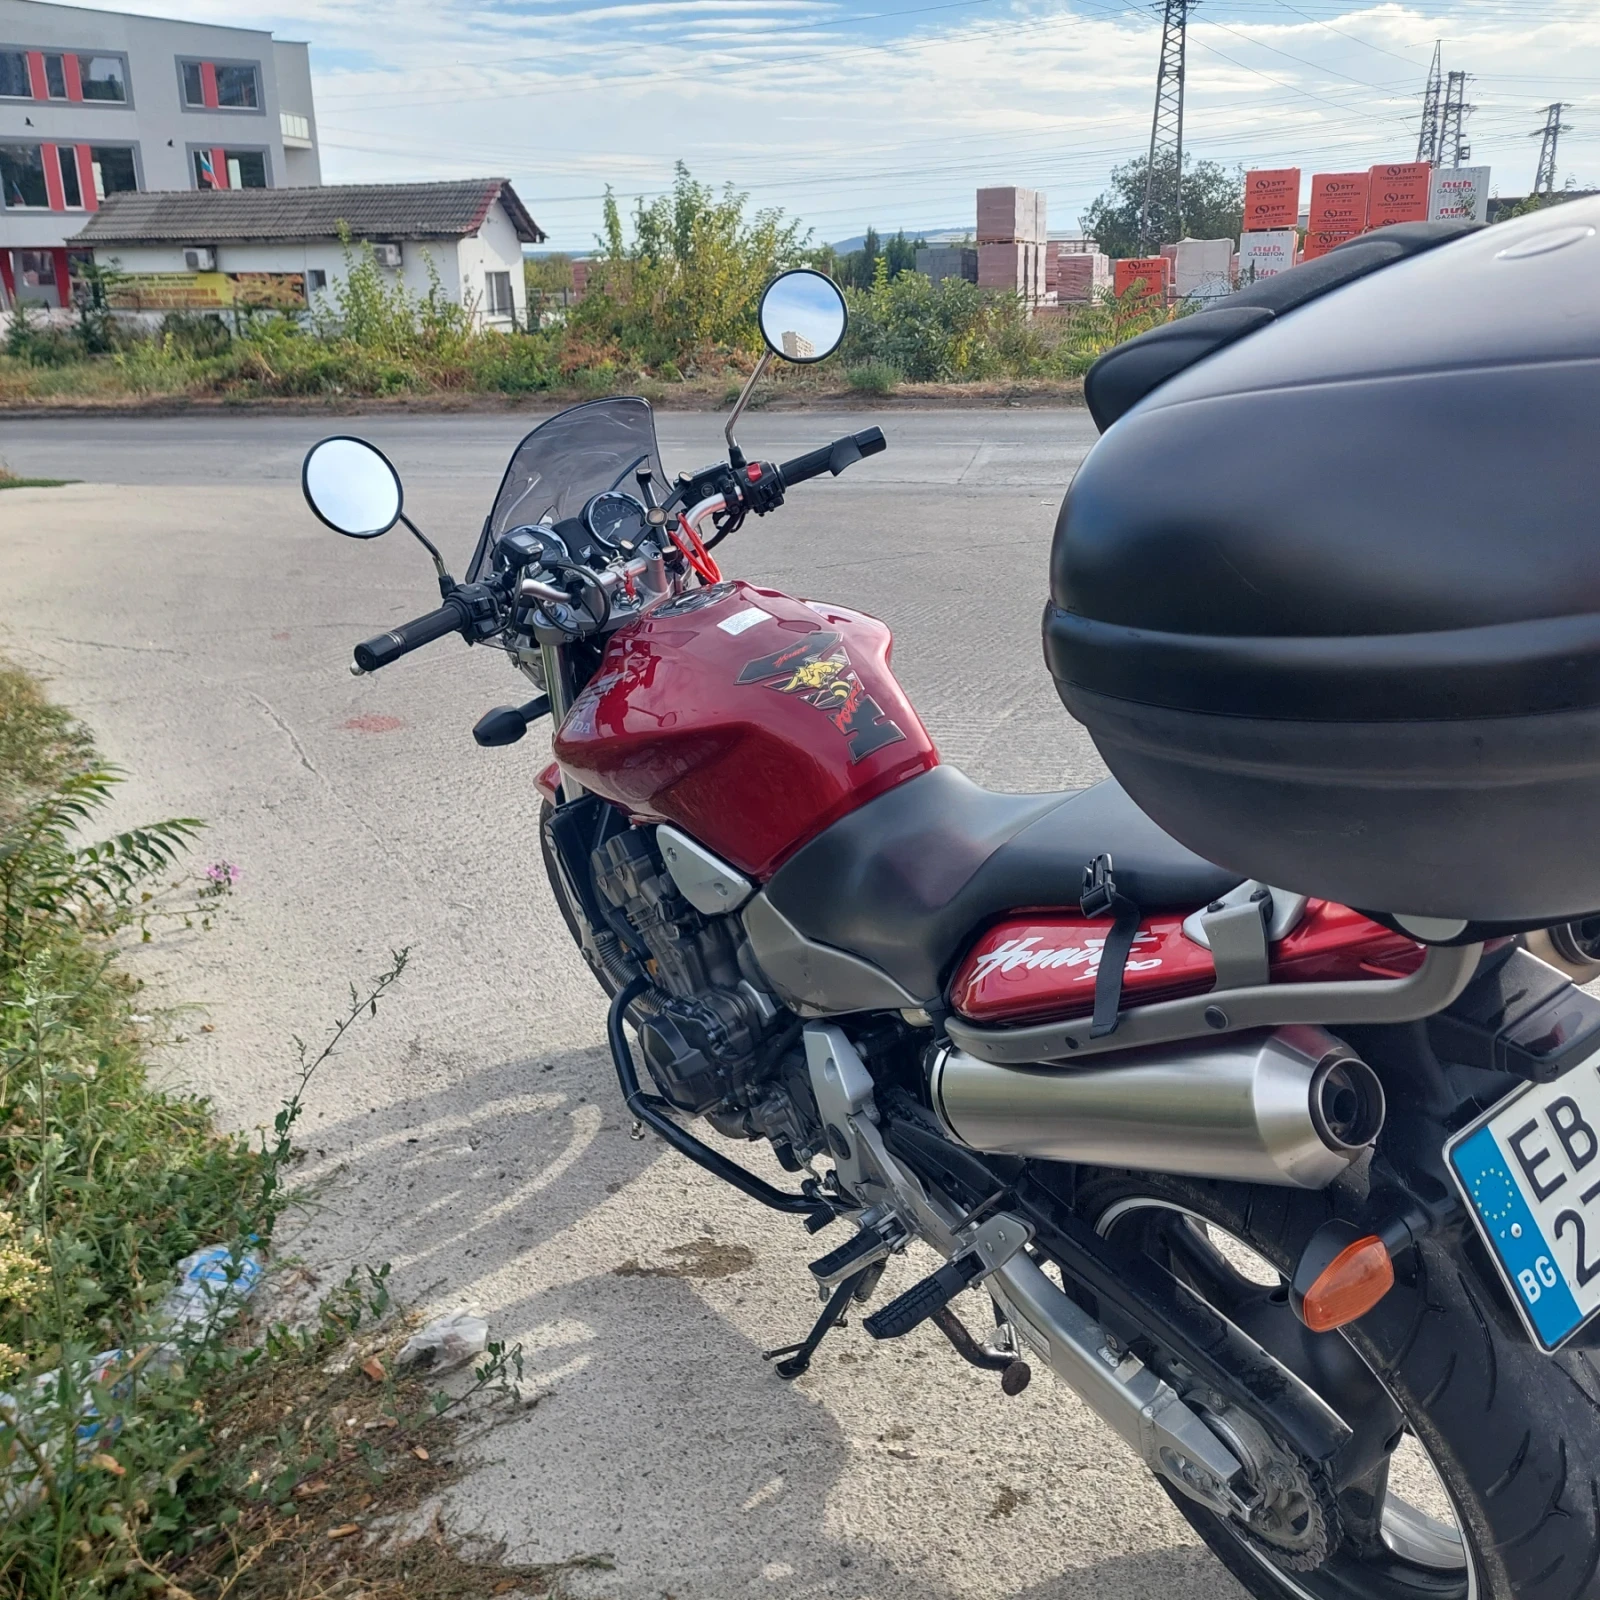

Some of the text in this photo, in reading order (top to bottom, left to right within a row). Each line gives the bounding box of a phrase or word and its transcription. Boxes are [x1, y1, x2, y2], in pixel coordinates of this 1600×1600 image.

[1442, 180, 1472, 188] nuh
[1507, 1096, 1598, 1203] EB
[1517, 1256, 1557, 1304] BG
